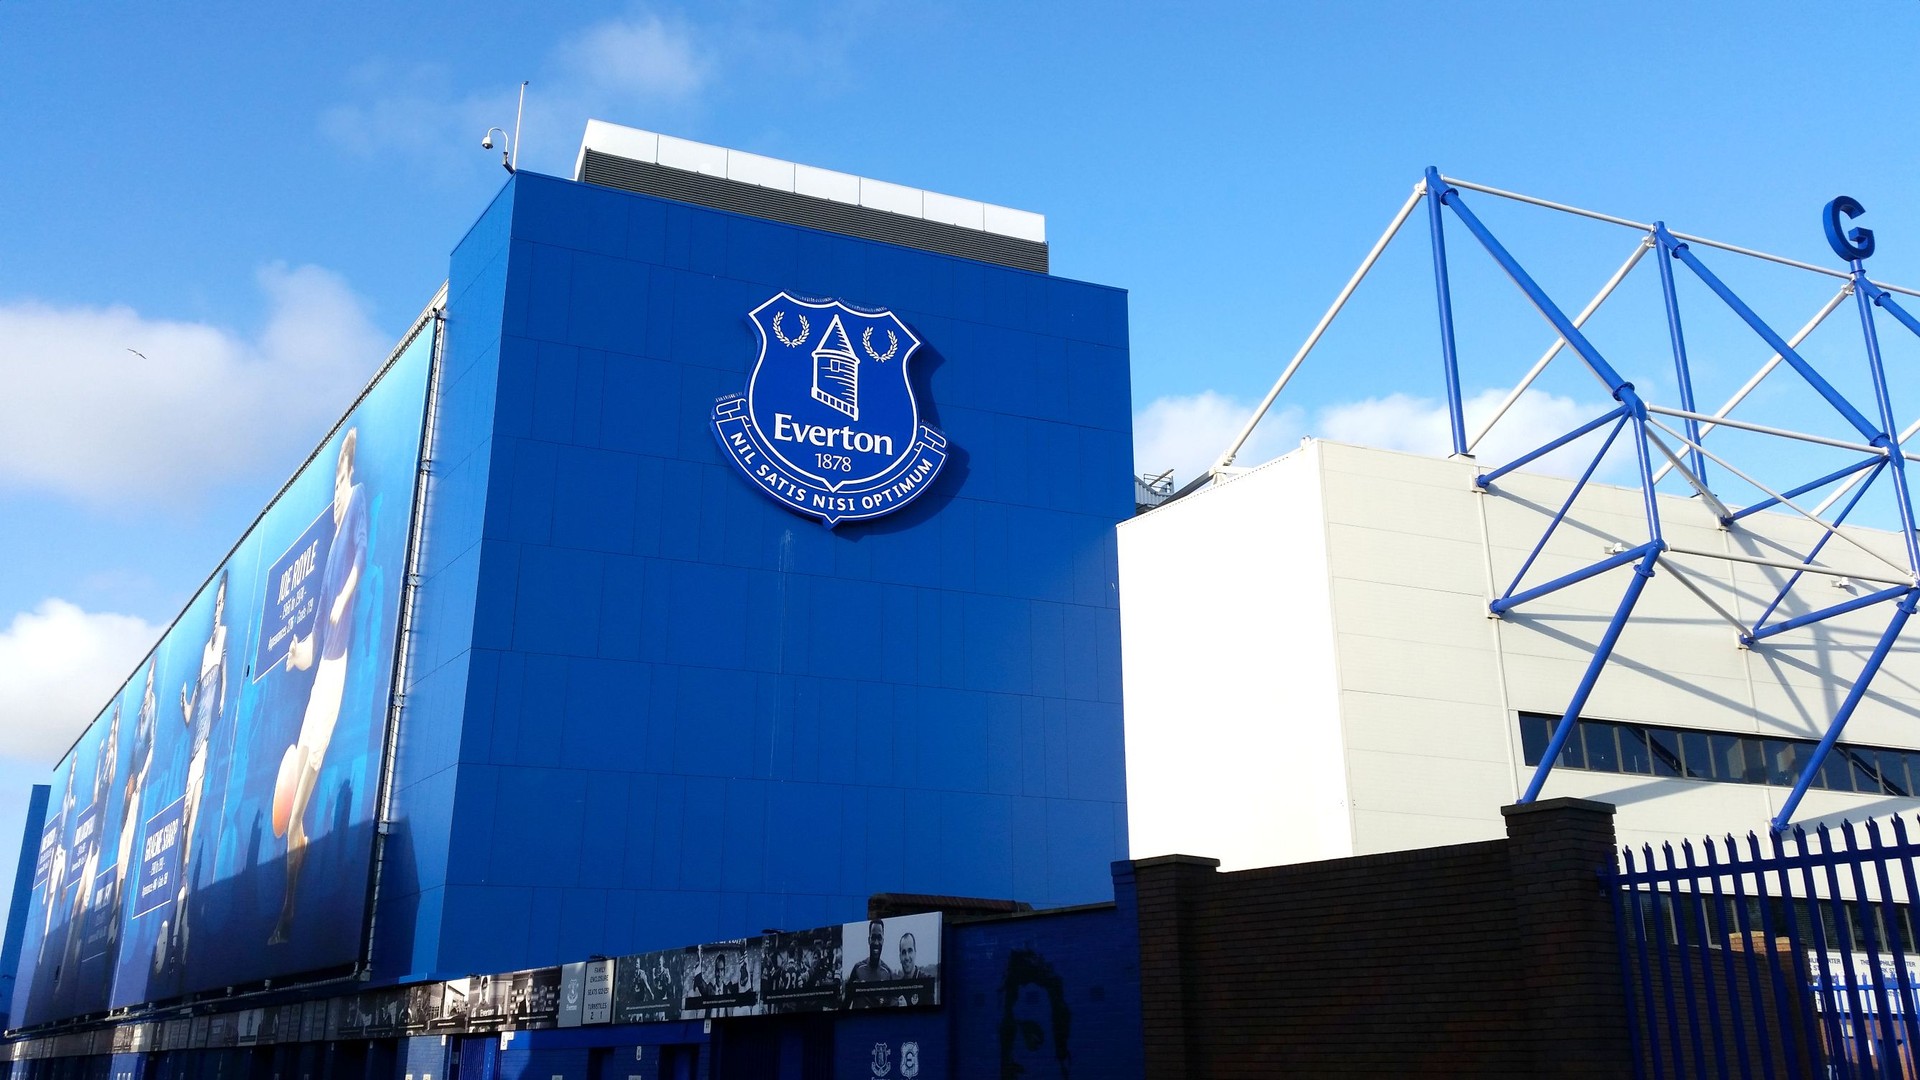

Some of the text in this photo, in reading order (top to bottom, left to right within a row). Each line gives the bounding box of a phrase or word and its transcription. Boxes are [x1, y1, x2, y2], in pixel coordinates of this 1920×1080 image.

[1823, 196, 1876, 262] G
[774, 413, 893, 456] Everton
[814, 452, 852, 473] 1878
[730, 432, 934, 511] NIL SATIS NISI OPTIMUM
[277, 539, 318, 605] JOE ROYLE
